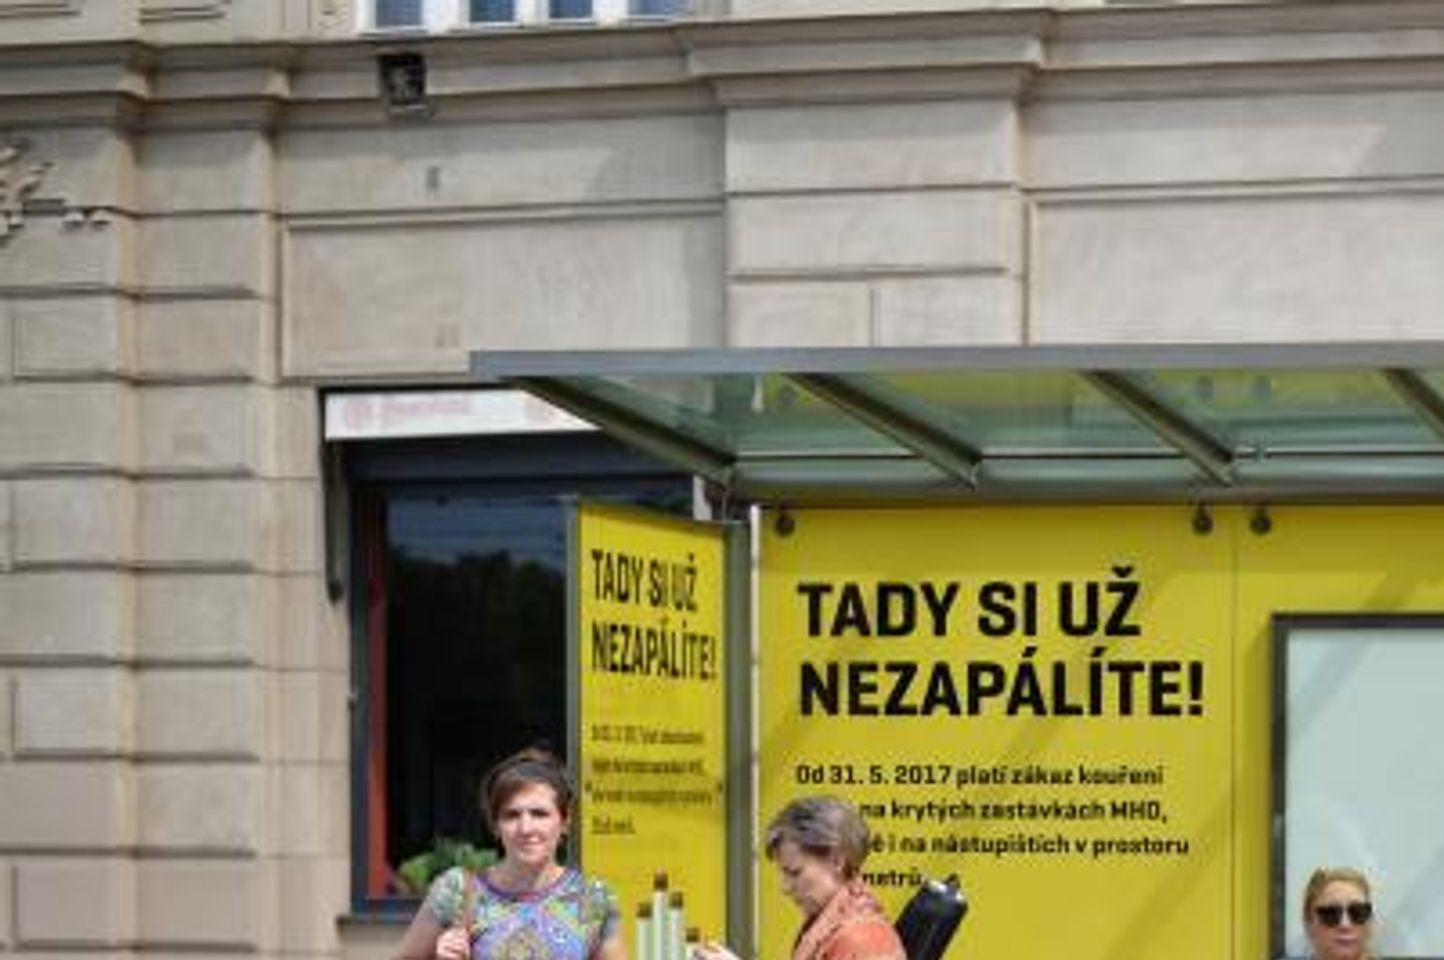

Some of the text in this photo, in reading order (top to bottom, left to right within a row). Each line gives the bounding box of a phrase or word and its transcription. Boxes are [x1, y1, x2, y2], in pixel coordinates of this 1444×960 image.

[591, 549, 643, 605] TADY
[649, 558, 669, 608] SI
[797, 566, 1142, 638] TADY SI UŽ
[592, 616, 716, 681] NEZAPÁLÍTE!
[799, 646, 1205, 716] NEZAPÁLÍTE!
[796, 764, 1164, 790] Od 31. 5. 2017 platí zákaz kouření
[859, 799, 1168, 823] na krytých zastávkách MHD,
[901, 838, 926, 853] na
[931, 834, 1070, 858] nástupištích
[1076, 840, 1088, 853] v
[1093, 836, 1190, 858] prostoru
